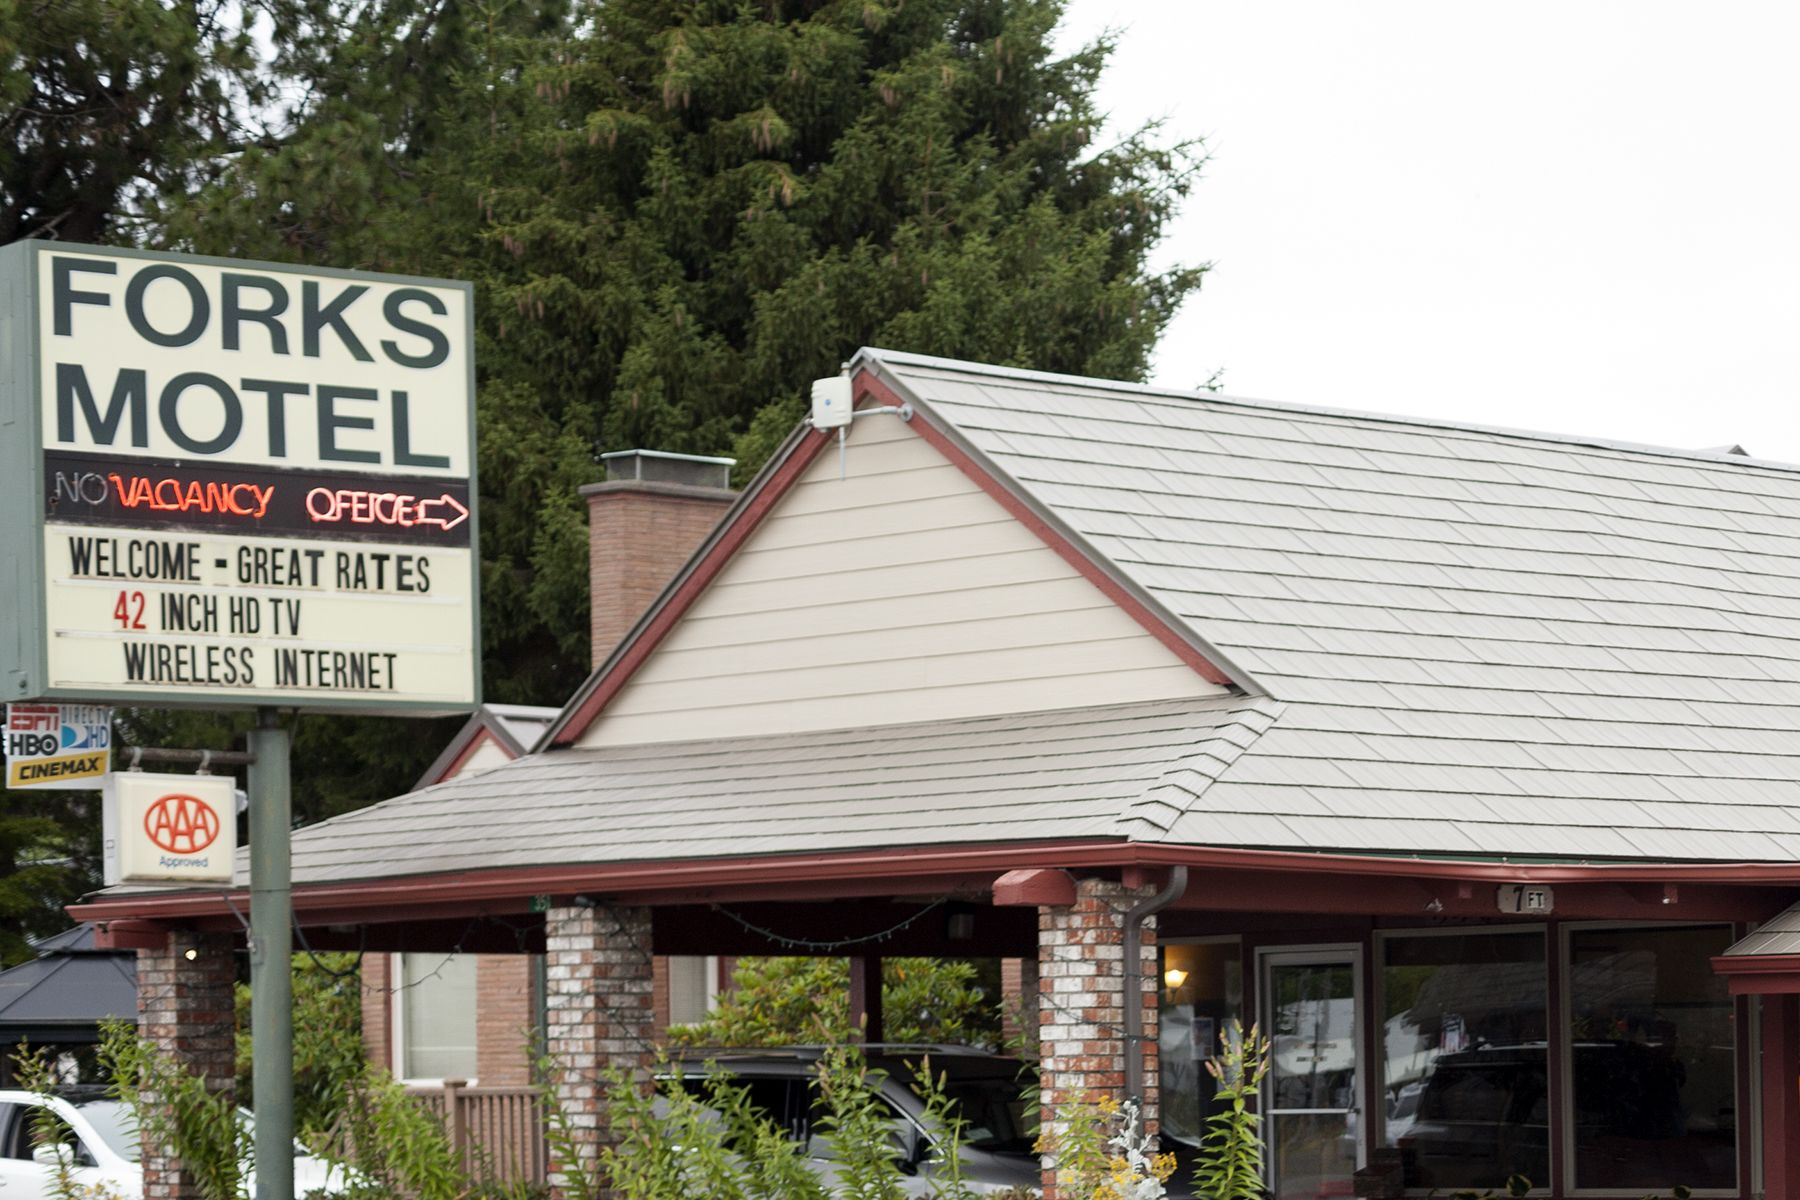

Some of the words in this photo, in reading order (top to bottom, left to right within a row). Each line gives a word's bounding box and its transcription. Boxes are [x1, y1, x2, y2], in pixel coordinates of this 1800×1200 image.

[52, 256, 450, 369] FORKS
[56, 363, 450, 469] MOTEL
[54, 472, 108, 505] NO
[108, 473, 275, 517] VACANCY
[306, 487, 416, 527] OFFICE
[69, 536, 201, 581] WELCOME
[238, 545, 325, 587] GREAT
[336, 551, 431, 593] RATES
[113, 590, 147, 630] 42
[160, 592, 218, 633] INCH
[230, 596, 260, 634] HD
[268, 598, 301, 636] TV
[123, 641, 255, 685] WIRELESS
[274, 647, 398, 690] INTERNET
[10, 705, 59, 731] ESPN
[89, 725, 109, 749] HD
[9, 733, 59, 756] HBO
[19, 757, 99, 780] CINEMAX
[149, 797, 214, 851] AAA
[159, 855, 209, 868] Approved
[1512, 885, 1525, 912] 7
[1528, 892, 1543, 907] FT
